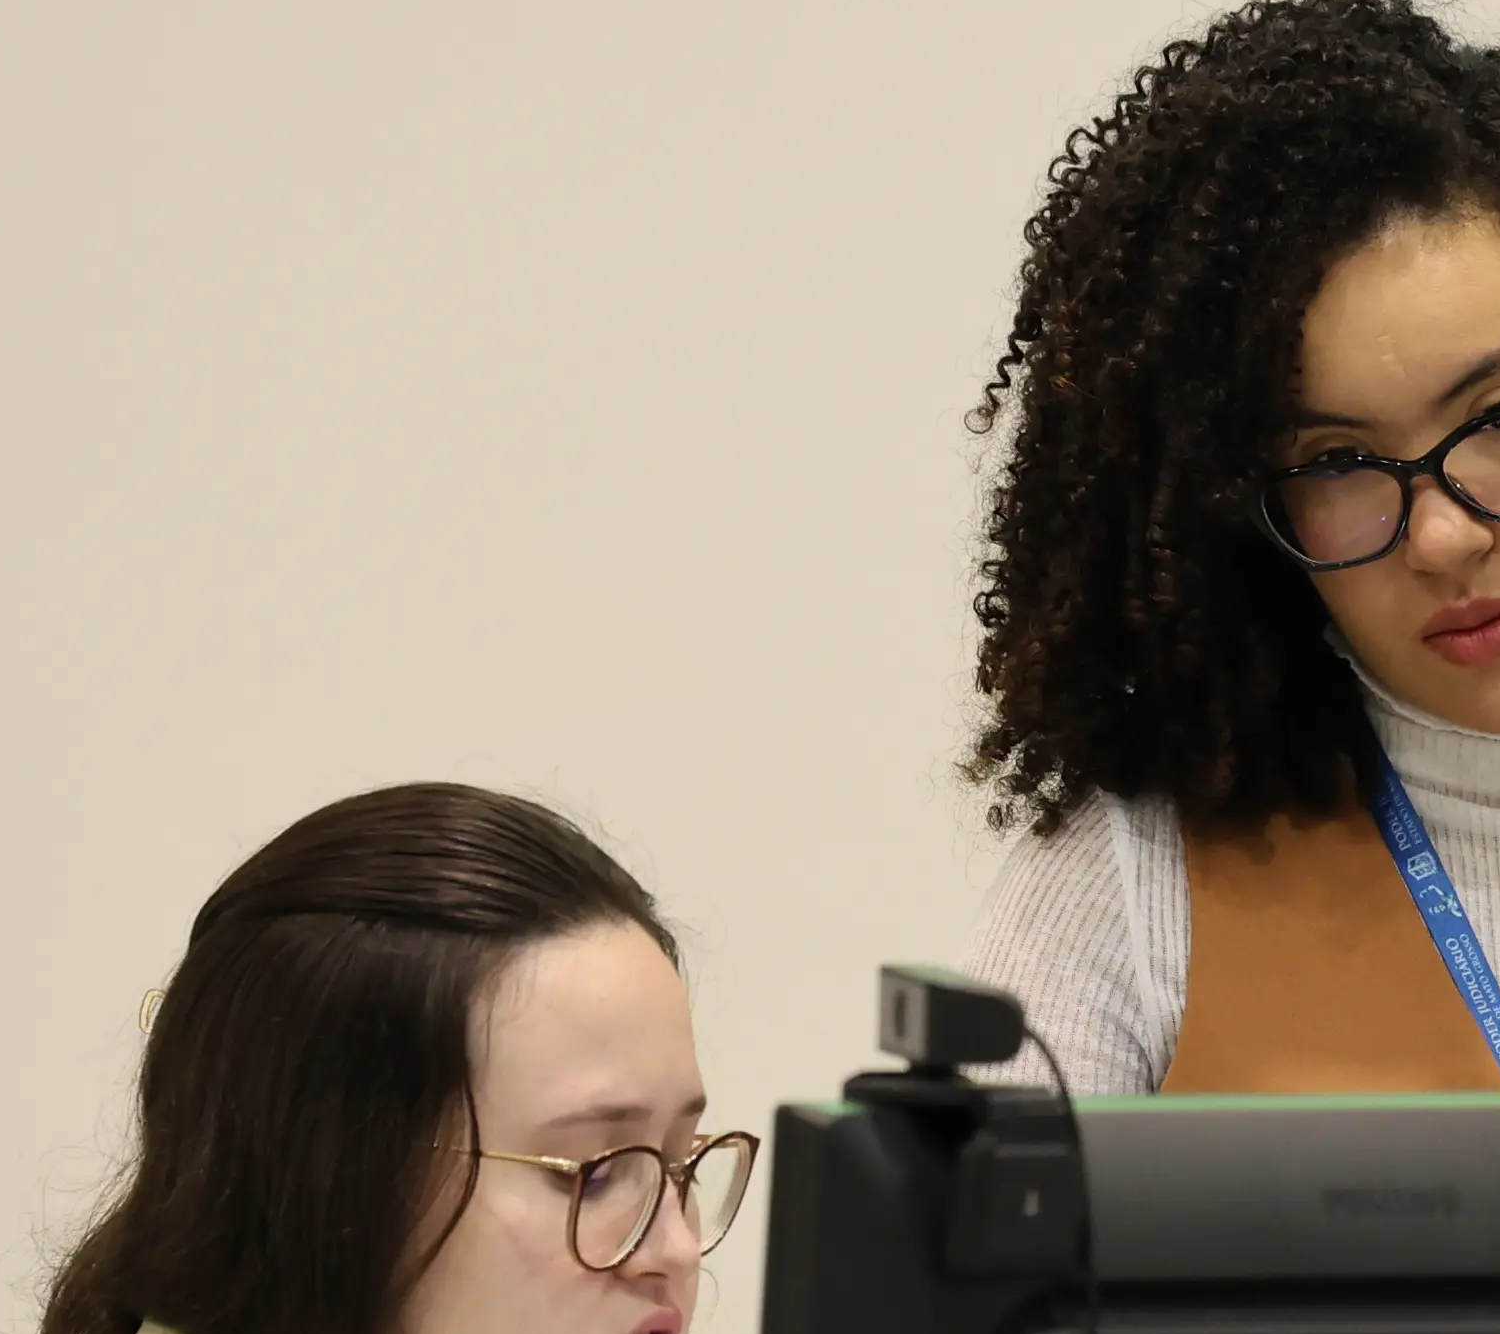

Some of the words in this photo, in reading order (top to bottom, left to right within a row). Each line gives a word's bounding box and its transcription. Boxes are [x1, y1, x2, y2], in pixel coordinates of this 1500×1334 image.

[1459, 933, 1484, 974] GROSSO
[1446, 938, 1490, 1014] JUDICIÁRIO
[1479, 975, 1497, 1004] MATO
